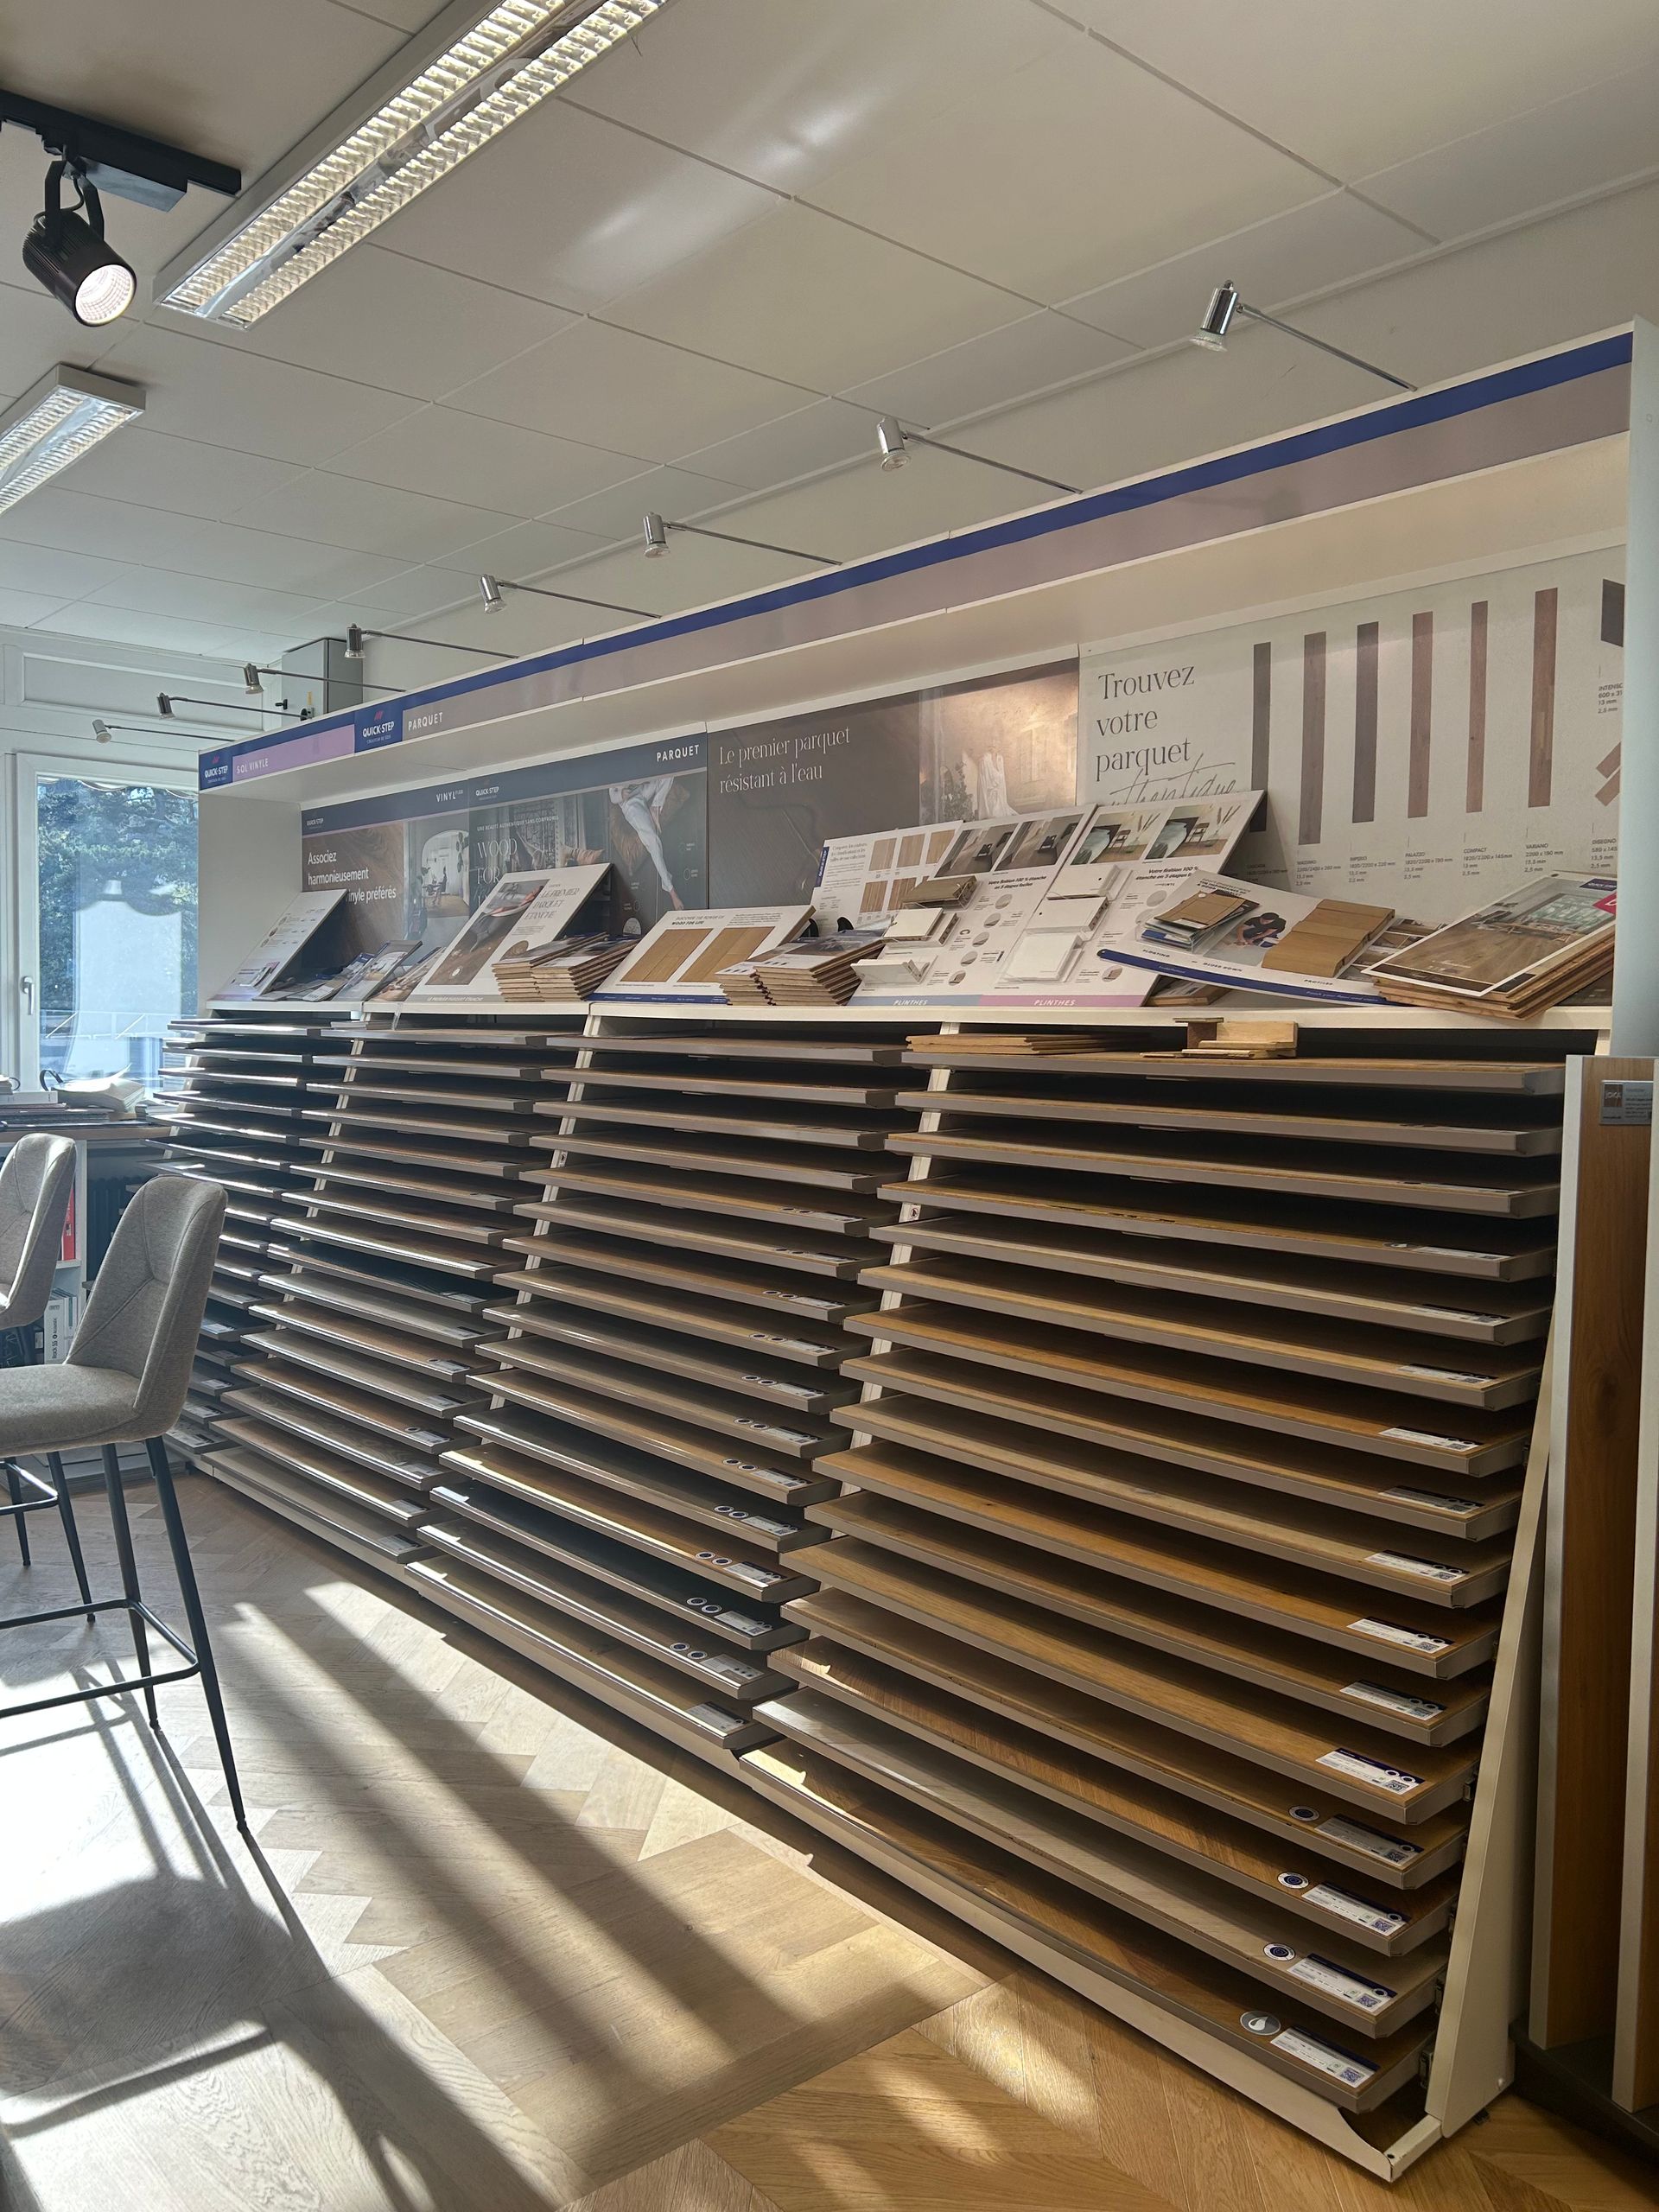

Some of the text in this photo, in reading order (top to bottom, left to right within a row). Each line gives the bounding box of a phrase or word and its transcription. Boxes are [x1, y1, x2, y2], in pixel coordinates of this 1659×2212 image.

[1098, 666, 1195, 699] Trouvez
[408, 712, 443, 731] PARQUET
[1096, 709, 1158, 736] votre
[657, 744, 700, 762] PARQUET
[720, 726, 850, 768] Le premier parquet
[236, 758, 269, 774] SOL VINYLE
[1096, 737, 1191, 782] parquet
[720, 763, 823, 794] résistant à l'eau
[308, 849, 337, 865] Associez
[478, 838, 518, 859] WOOD
[308, 868, 369, 886] harmonieusement
[477, 866, 500, 884] FOR
[346, 884, 397, 906] inyle préférés
